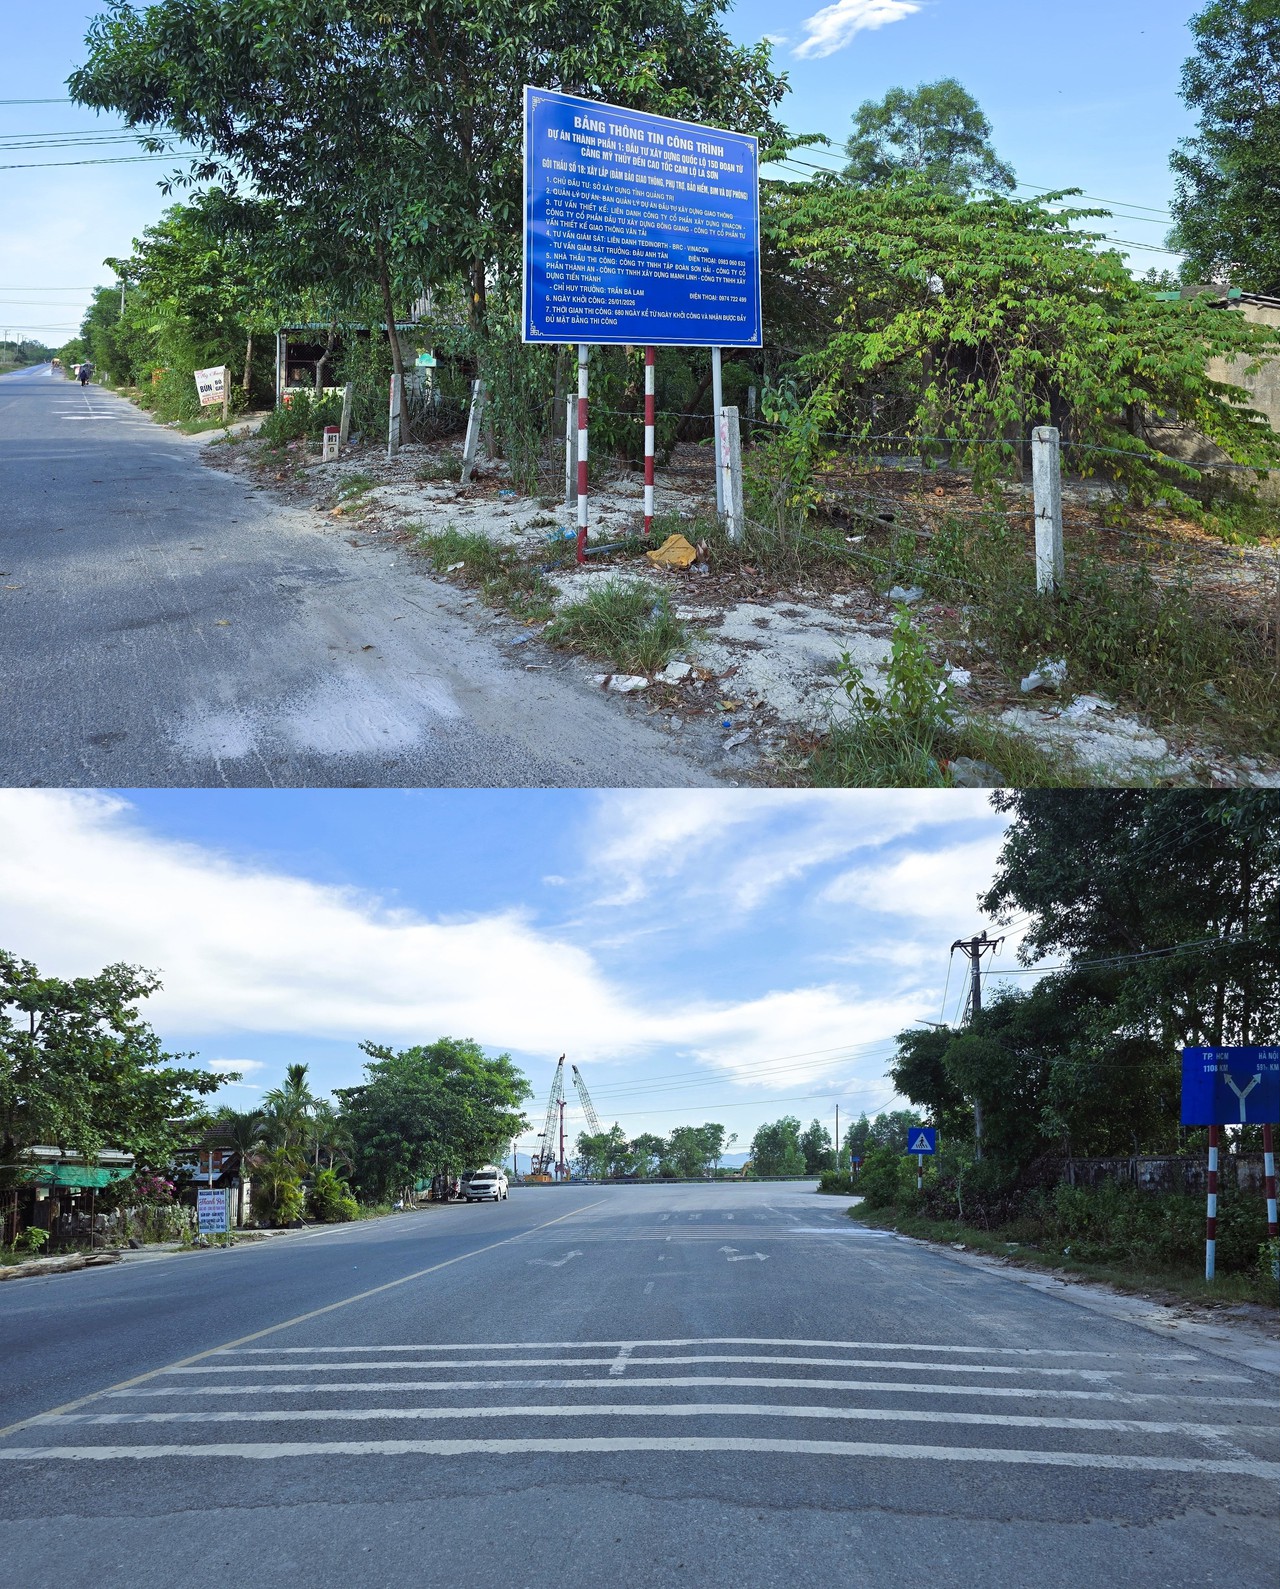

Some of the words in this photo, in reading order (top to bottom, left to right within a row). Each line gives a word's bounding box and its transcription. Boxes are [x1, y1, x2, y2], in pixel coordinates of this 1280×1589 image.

[574, 115, 606, 134] BẢNG
[609, 123, 644, 141] THÔNG
[648, 132, 663, 145] TIN
[667, 134, 693, 151] CÔNG
[696, 140, 724, 157] TRÌNH
[548, 129, 558, 141] DỰ
[560, 130, 570, 141] ÁN
[572, 133, 595, 146] THÀNH
[598, 138, 616, 150] PHẦN
[618, 142, 624, 151] 1:
[626, 142, 638, 154] ĐẦU
[640, 146, 648, 156] TƯ
[650, 148, 662, 158] XÂY
[664, 151, 680, 161] DỰNG
[682, 154, 697, 165] QUỐC
[699, 157, 706, 168] LỘ
[708, 159, 718, 168] 15D
[720, 161, 735, 172] ĐOẠN
[736, 164, 743, 173] TỪ
[581, 146, 600, 159] CẢNG
[602, 150, 613, 161] MỸ
[615, 153, 631, 165] THỦY
[633, 155, 646, 167] ĐẾN
[648, 160, 659, 170] CAO
[661, 160, 673, 172] TỐC
[674, 164, 688, 174] CAM
[690, 165, 696, 177] LỘ
[698, 169, 705, 177] LA
[707, 170, 718, 180] SƠN
[542, 158, 552, 169] GÓI
[553, 159, 567, 171] THẦU
[569, 161, 576, 173] SỐ
[587, 165, 597, 176] XÂY
[599, 166, 608, 178] LẮP
[610, 169, 623, 180] (ĐẢM
[624, 171, 634, 182] BẢO
[687, 182, 696, 192] BẢO
[553, 188, 570, 197] QUẢN
[568, 178, 580, 187] ĐẦU
[602, 184, 613, 192] XÂY
[632, 188, 644, 197] TỈNH
[646, 191, 664, 200] QUẢNG
[546, 208, 564, 217] CÔNG
[576, 211, 585, 220] CỔ
[587, 213, 602, 222] PHẦN
[604, 214, 616, 223] ĐẦU
[565, 200, 577, 209] VẤN
[580, 202, 596, 211] THIẾT
[599, 204, 608, 213] KẾ:
[644, 211, 658, 219] CÔNG
[546, 217, 558, 226] VẤN
[560, 219, 577, 228] THIẾT
[579, 221, 587, 230] KẾ
[605, 225, 624, 234] THÔNG
[563, 230, 574, 239] VẤN
[576, 232, 591, 241] GIÁM
[593, 234, 606, 242] SÁT:
[563, 241, 575, 250] VẤN
[577, 243, 592, 252] GIÁM
[593, 245, 604, 253] SÁT
[554, 252, 567, 260] NHÀ
[570, 253, 585, 262] THẦU
[599, 256, 617, 265] CÔNG:
[620, 258, 635, 266] CÔNG
[546, 261, 564, 270] PHẦN
[565, 263, 585, 272] THÀNH
[600, 266, 616, 274] CÔNG
[566, 272, 579, 281] TIẾN
[581, 274, 601, 282] THÀNH
[608, 286, 623, 294] TRẦN
[553, 294, 570, 302] NGÀY
[588, 296, 607, 304] CÔNG:
[556, 315, 570, 324] MẶT
[571, 315, 588, 324] BẰNG
[1258, 1050, 1267, 1059] HÀ
[1268, 1050, 1279, 1061] NỘI
